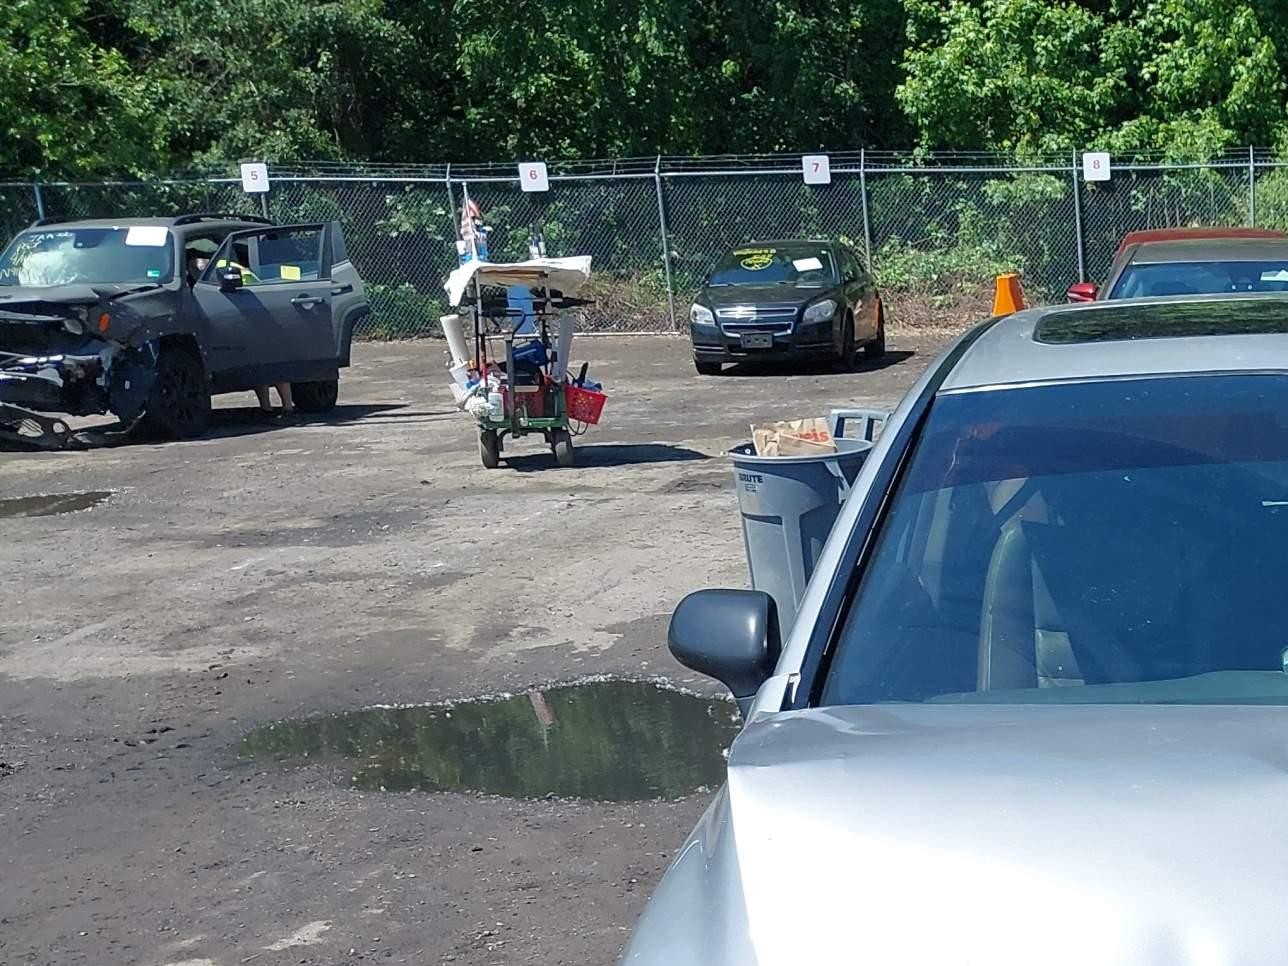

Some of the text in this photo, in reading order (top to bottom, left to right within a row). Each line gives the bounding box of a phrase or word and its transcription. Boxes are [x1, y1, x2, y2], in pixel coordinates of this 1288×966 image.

[812, 162, 820, 173] 7
[1092, 159, 1101, 170] 8
[250, 170, 259, 181] 5
[529, 169, 538, 180] 6
[738, 472, 764, 484] BRUTE
